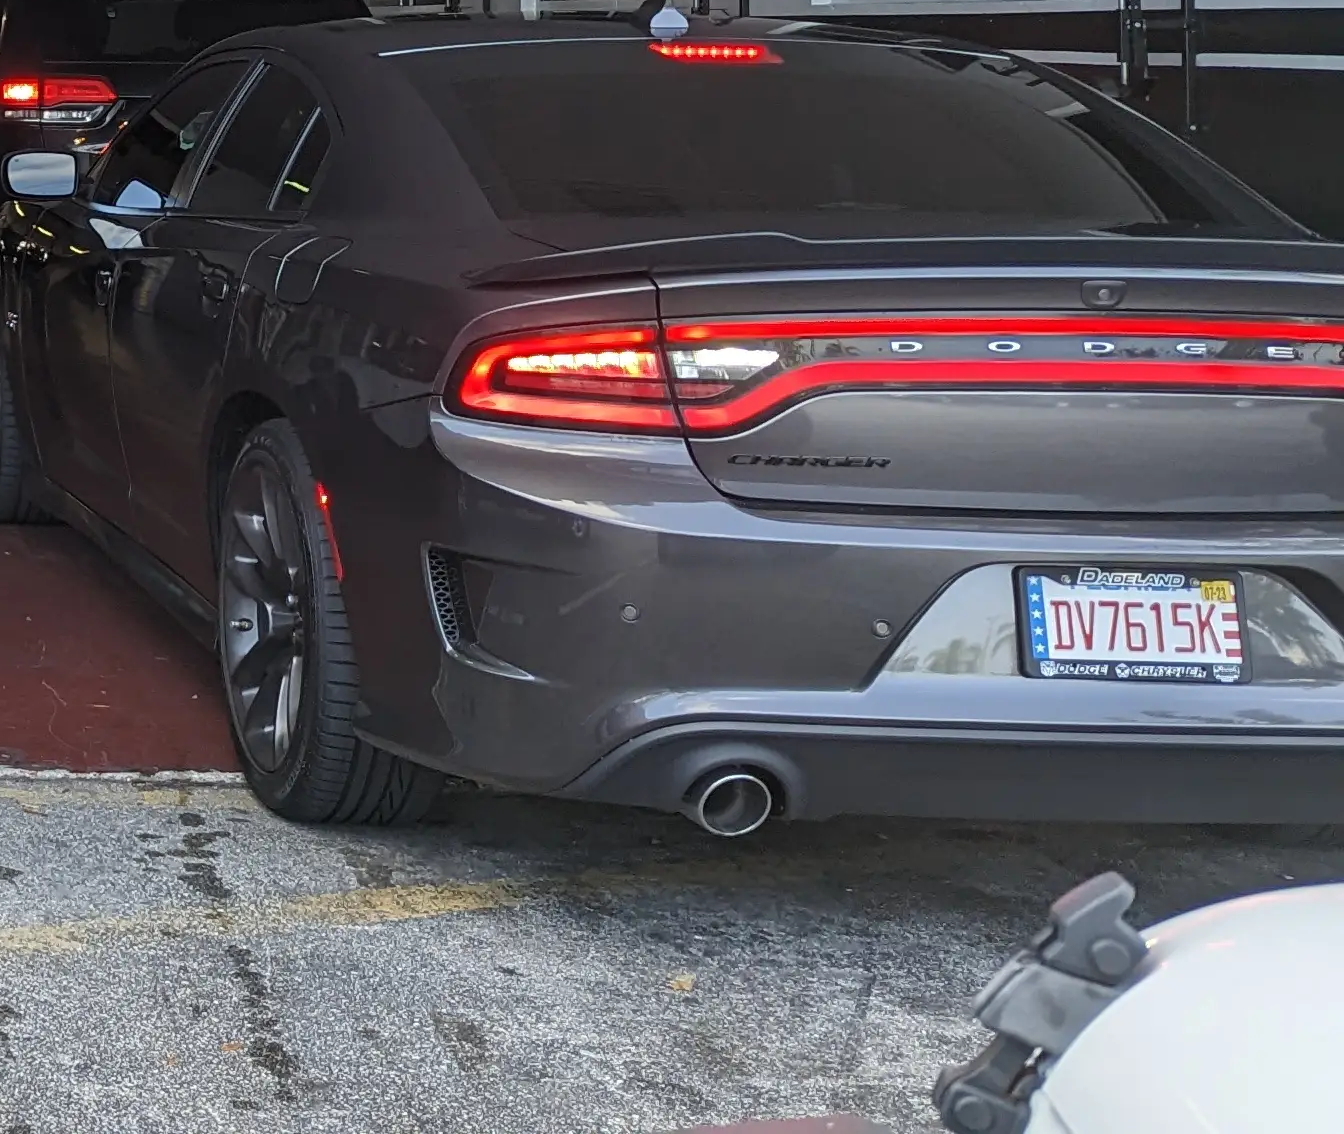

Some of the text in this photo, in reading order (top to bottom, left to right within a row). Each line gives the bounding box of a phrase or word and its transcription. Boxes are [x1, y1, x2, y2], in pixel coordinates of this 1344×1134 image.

[888, 340, 1296, 359] DODGE
[727, 453, 892, 469] CHARGER
[1077, 567, 1185, 588] DADELAND
[1050, 599, 1222, 654] DV7615K
[1055, 664, 1109, 676] DODGE
